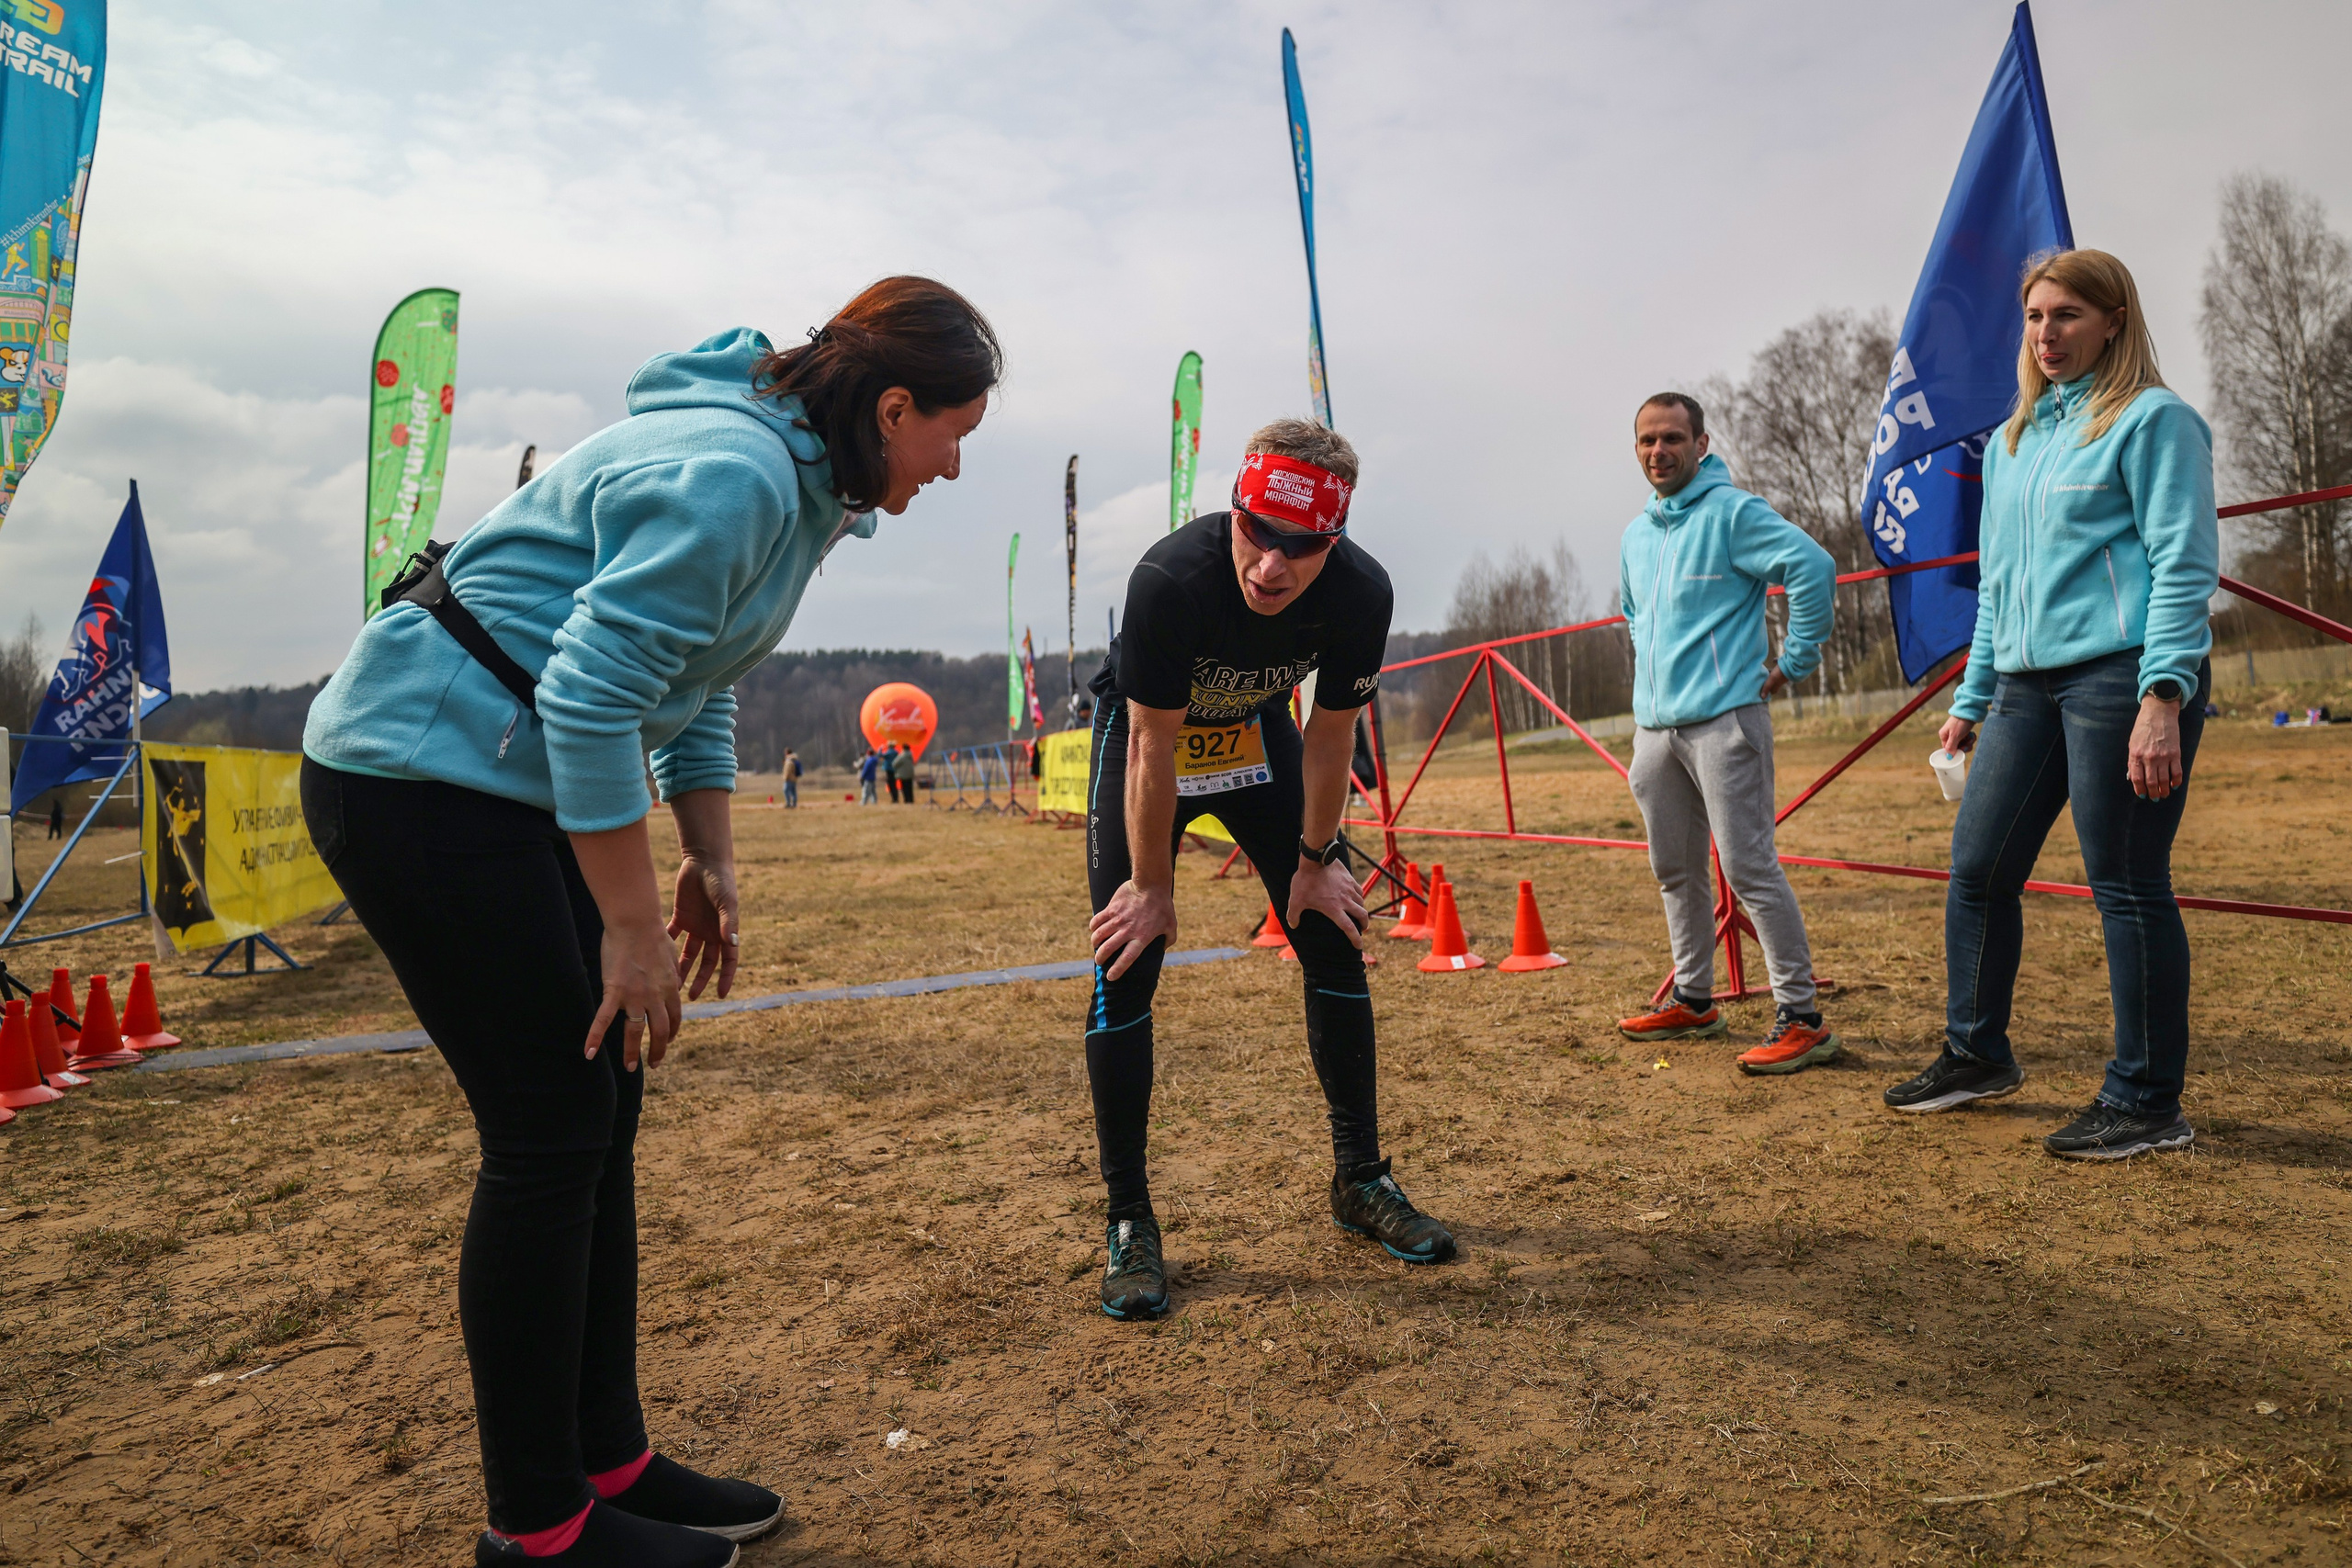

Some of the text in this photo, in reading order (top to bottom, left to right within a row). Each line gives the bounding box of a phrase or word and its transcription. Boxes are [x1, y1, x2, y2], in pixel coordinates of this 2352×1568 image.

[1267, 478, 1314, 497] ЛЫЖНЫЙ
[1264, 490, 1310, 512] МАРАФОН
[1188, 729, 1241, 759] 927
[1185, 754, 1245, 770] Баранов Евгений
